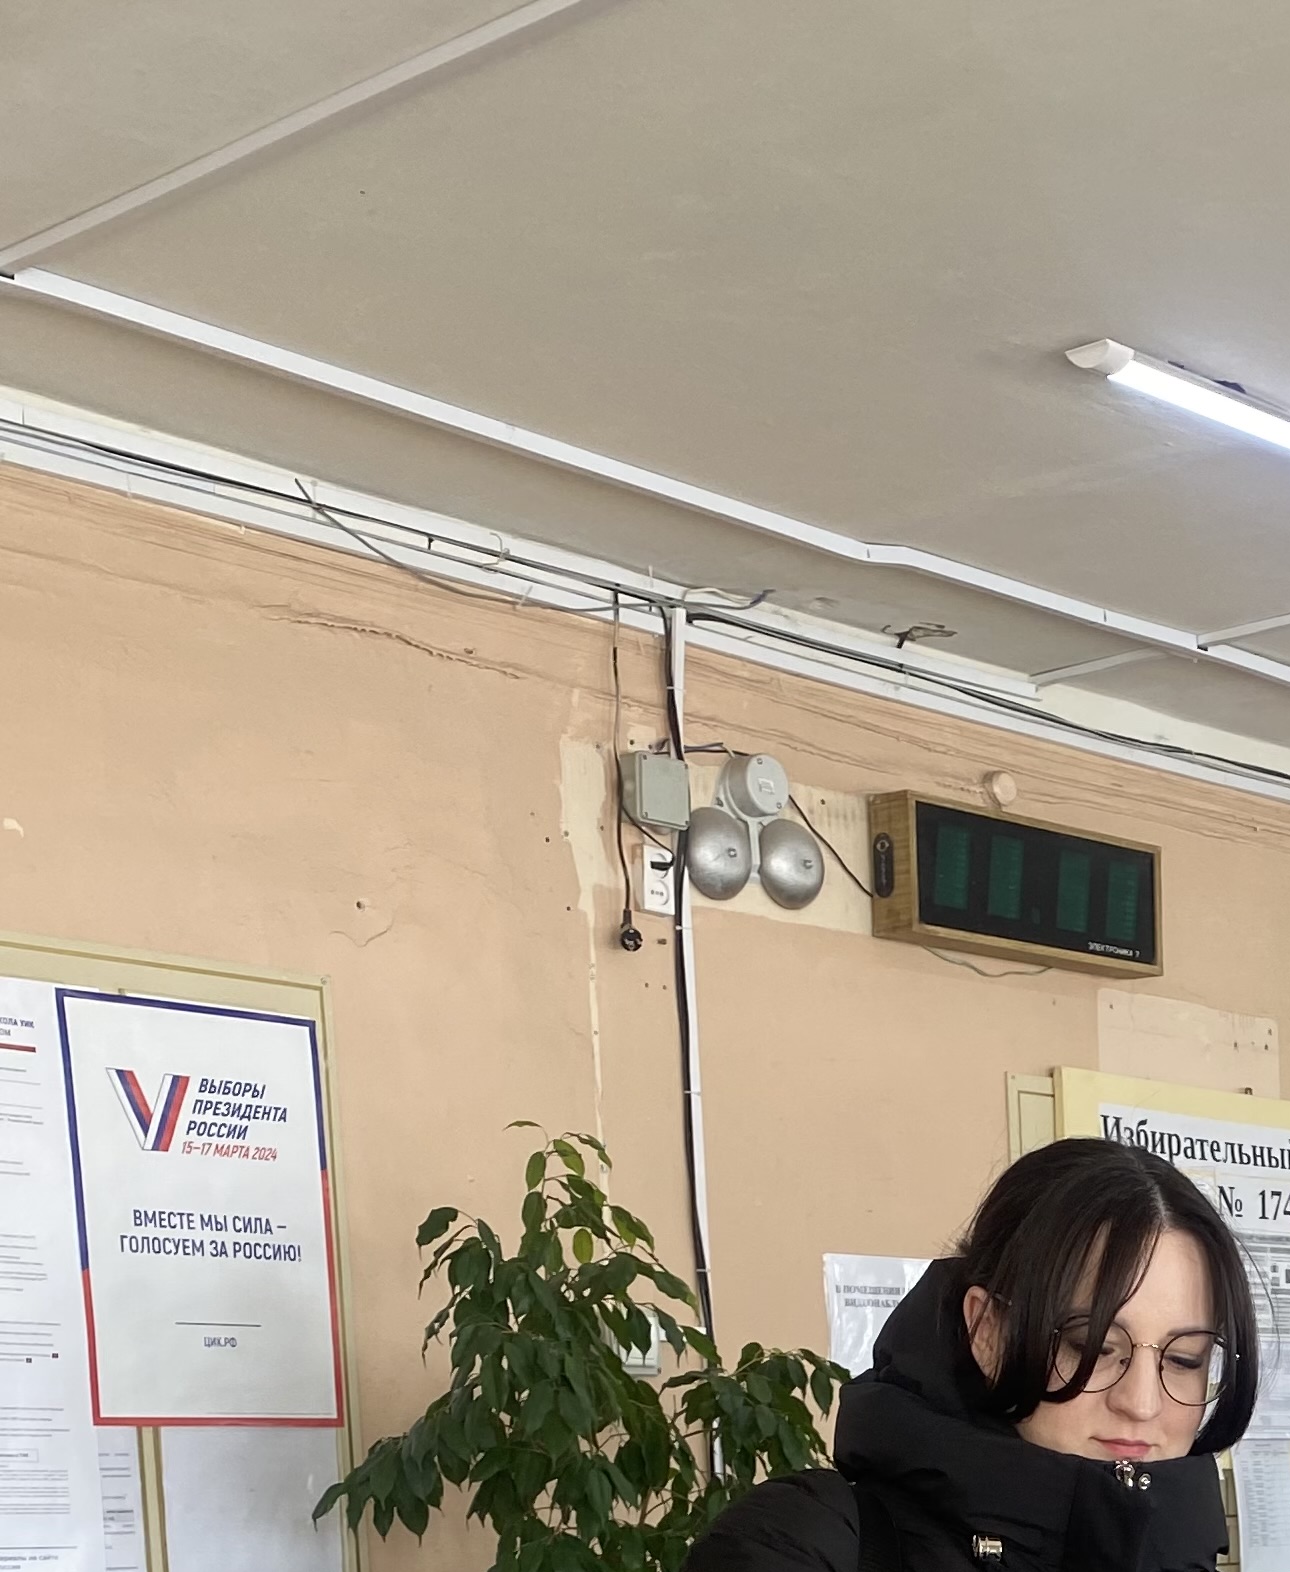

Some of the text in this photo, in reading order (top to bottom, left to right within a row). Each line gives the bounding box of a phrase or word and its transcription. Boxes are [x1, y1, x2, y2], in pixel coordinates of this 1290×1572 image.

[198, 1078, 266, 1099] ВЫБОРЫ
[192, 1099, 288, 1123] ПРЕЗИДЕНТА
[186, 1120, 249, 1140] РОССИИ
[214, 1145, 250, 1159] МАРТА
[251, 1147, 278, 1162] 2024
[133, 1209, 196, 1230] ВМЕСТЕ
[200, 1213, 228, 1233] МЫ
[232, 1216, 274, 1235] СИЛА
[119, 1235, 302, 1262] ГОЛОСУЕМ ЗА РОССИЮ!
